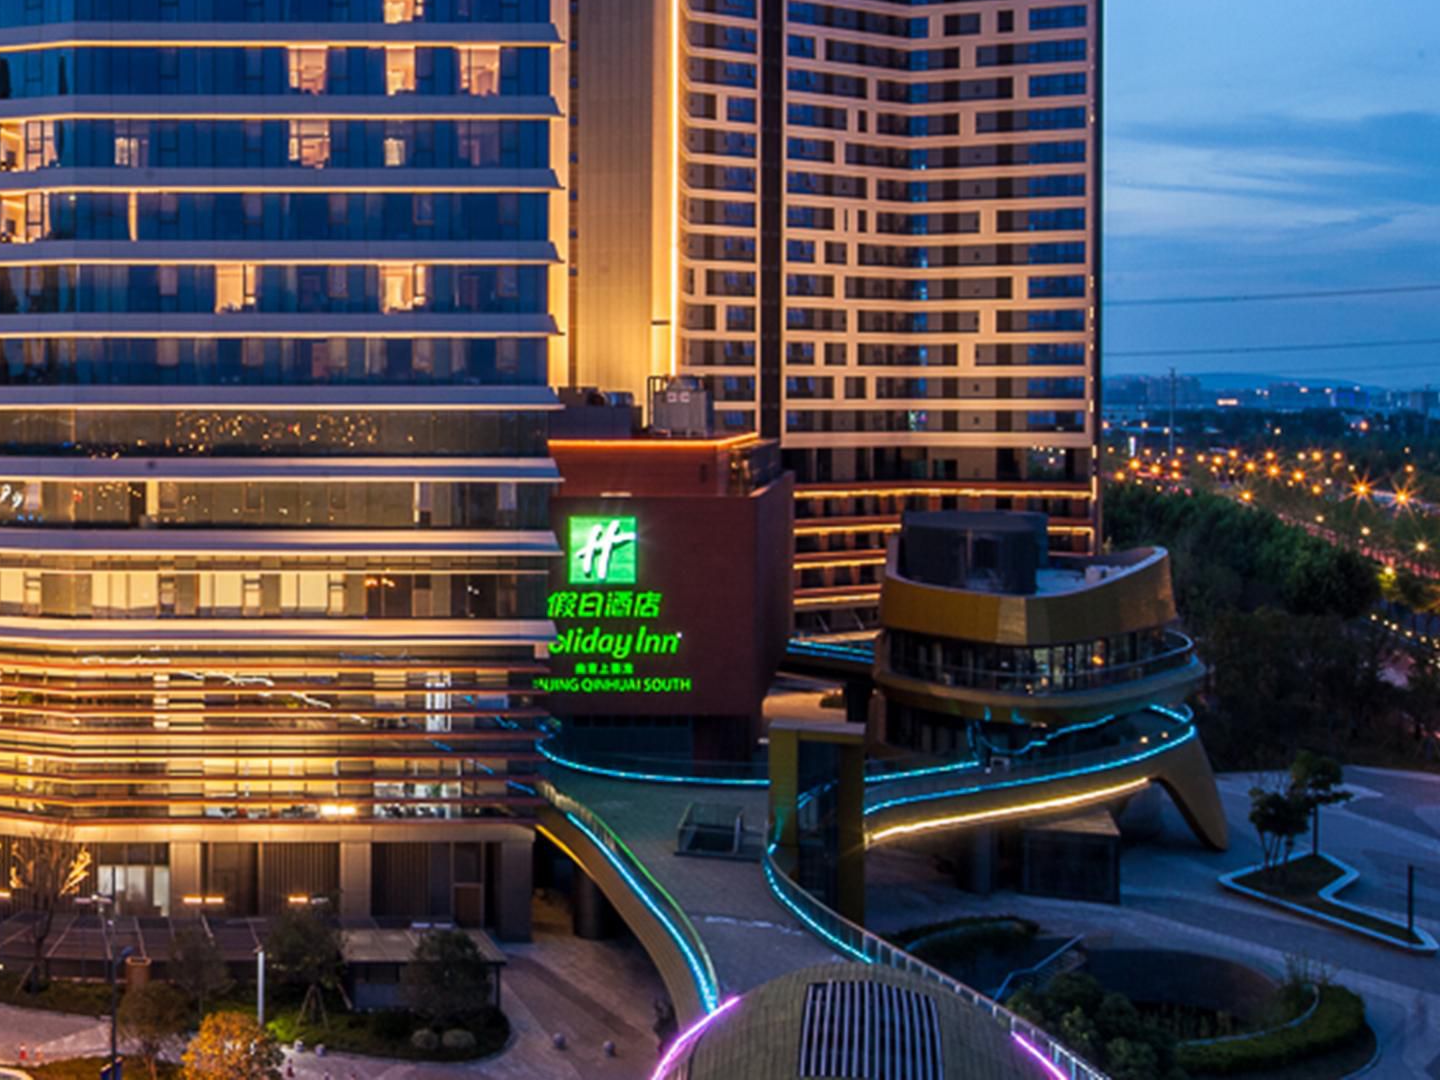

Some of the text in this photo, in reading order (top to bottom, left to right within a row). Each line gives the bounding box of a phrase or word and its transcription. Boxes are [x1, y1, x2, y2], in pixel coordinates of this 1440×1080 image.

[547, 591, 662, 618] 假日酒店
[548, 625, 680, 658] oliday Inn
[643, 677, 692, 692] SOUTH
